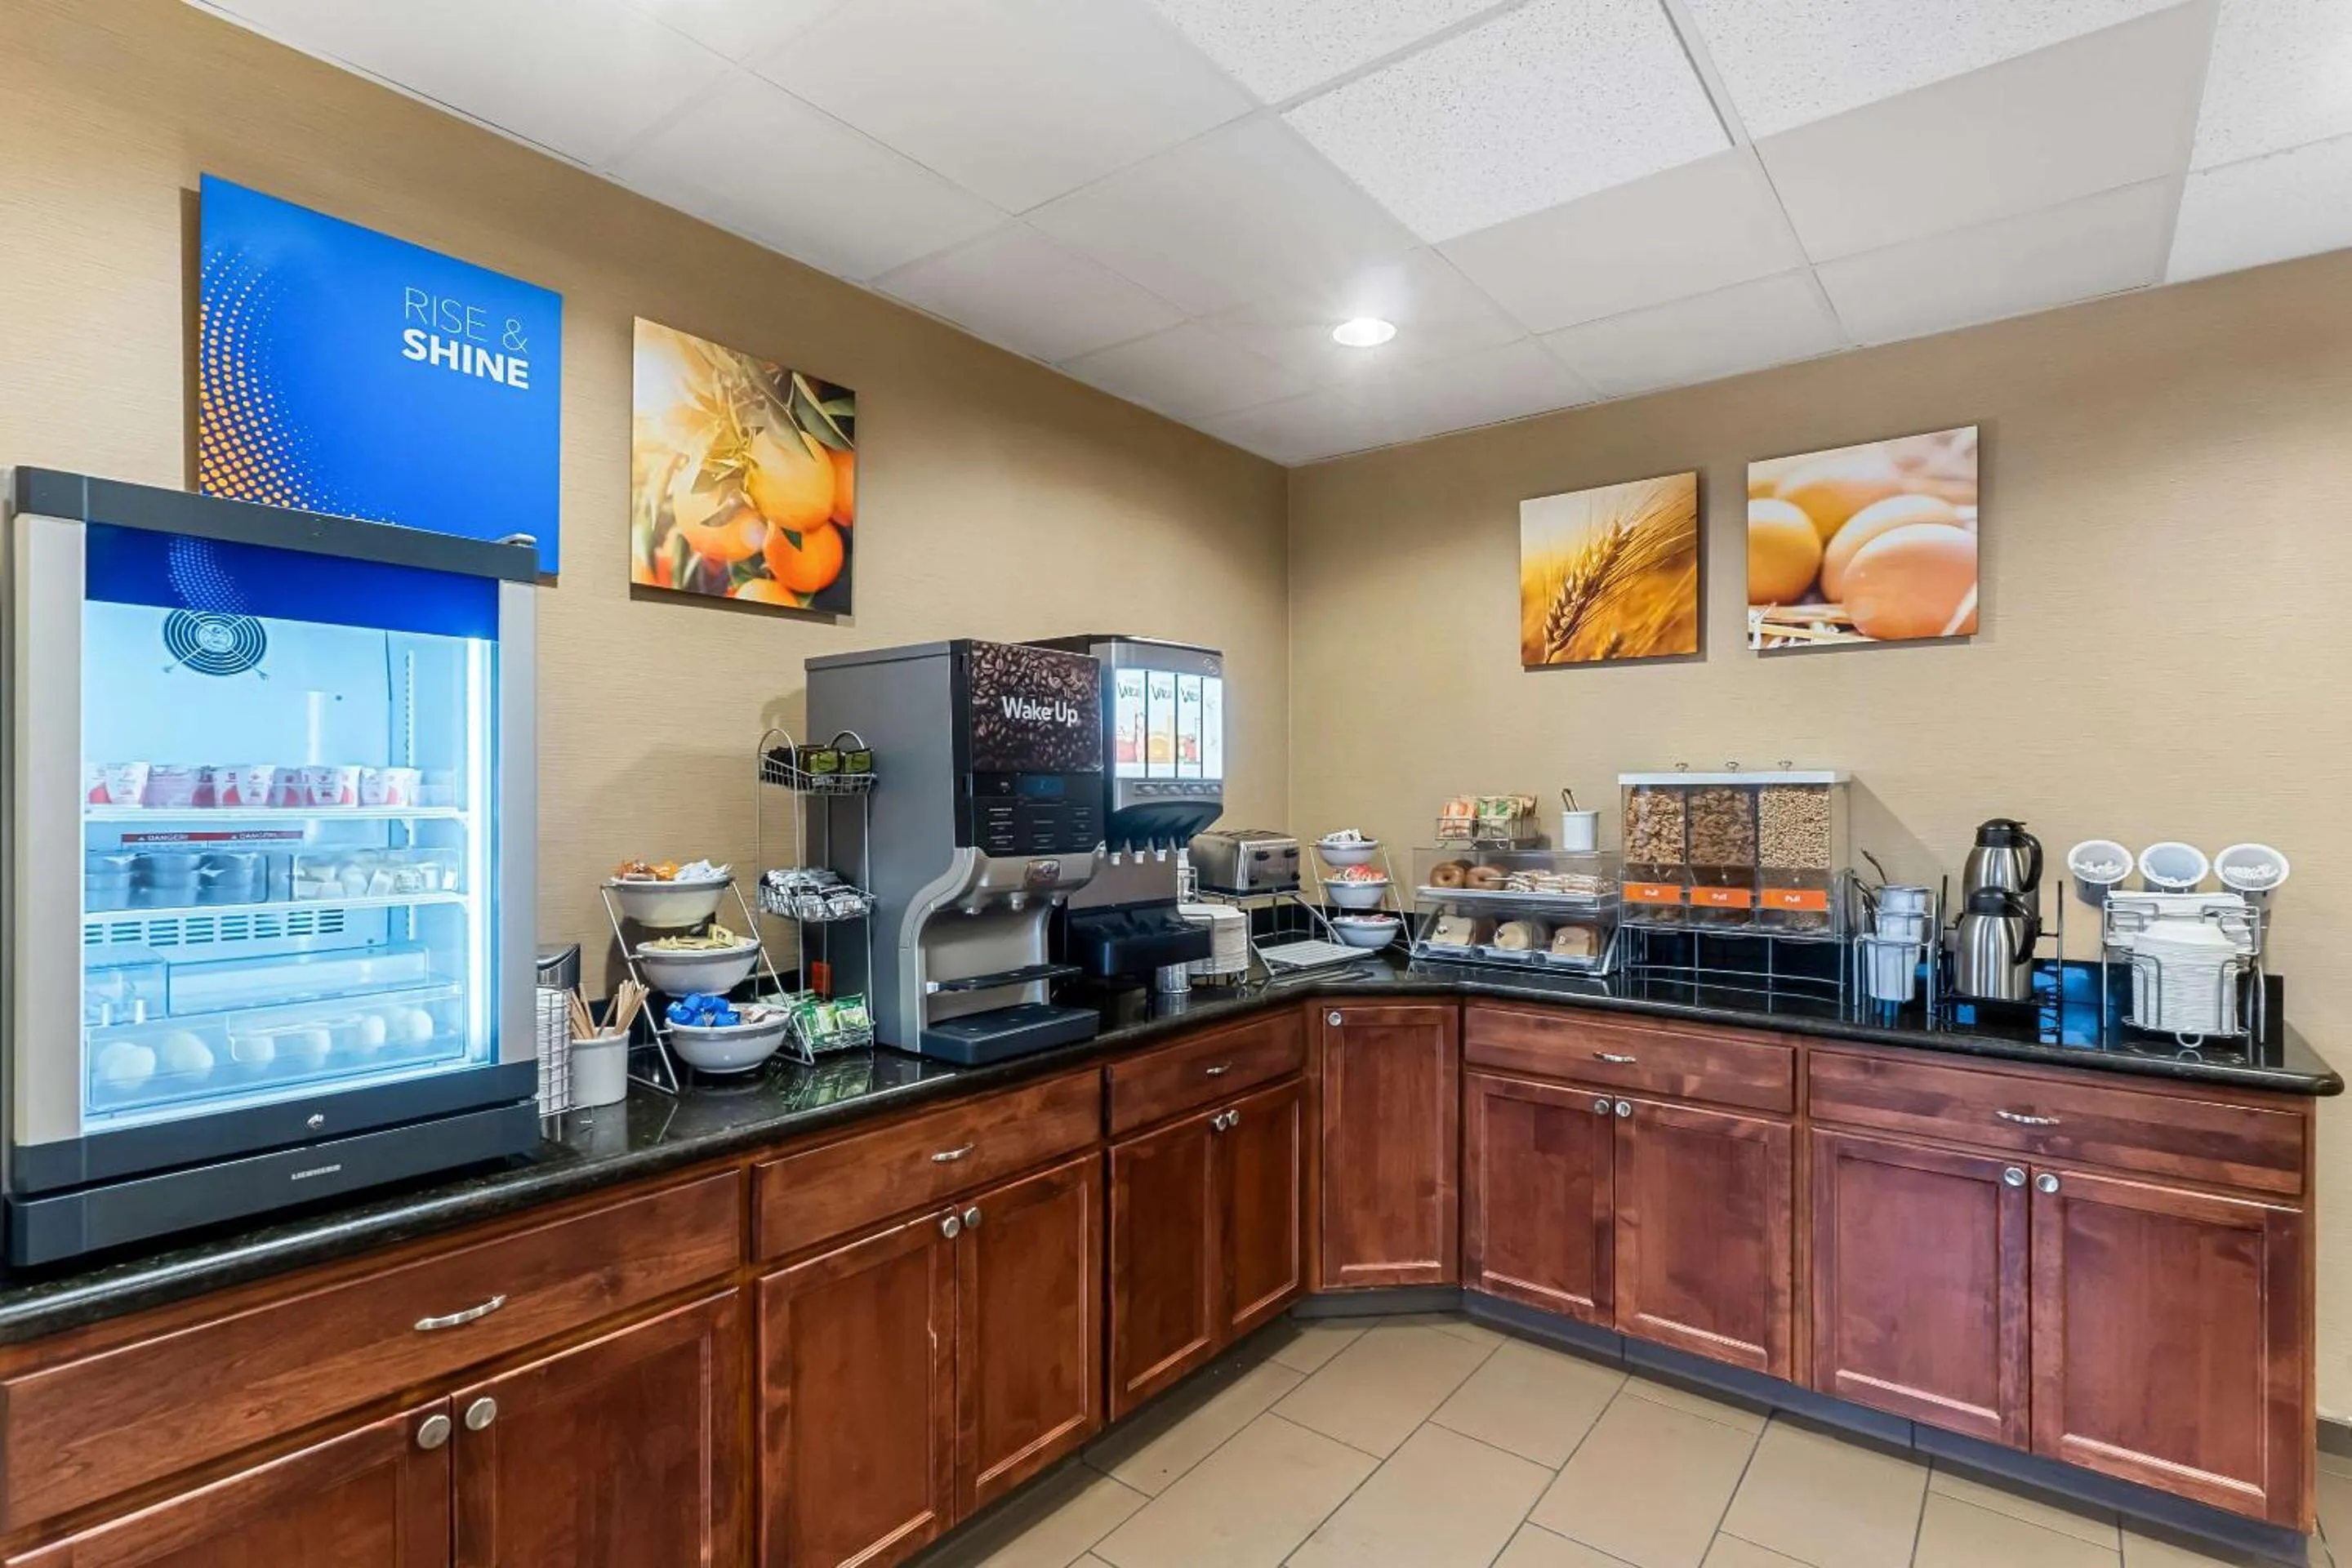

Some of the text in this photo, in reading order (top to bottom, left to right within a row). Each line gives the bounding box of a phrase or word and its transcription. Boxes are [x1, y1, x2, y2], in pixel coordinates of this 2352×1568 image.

[405, 287, 528, 354] RISE &
[402, 328, 529, 390] SHINE
[1000, 695, 1078, 728] Wake Up
